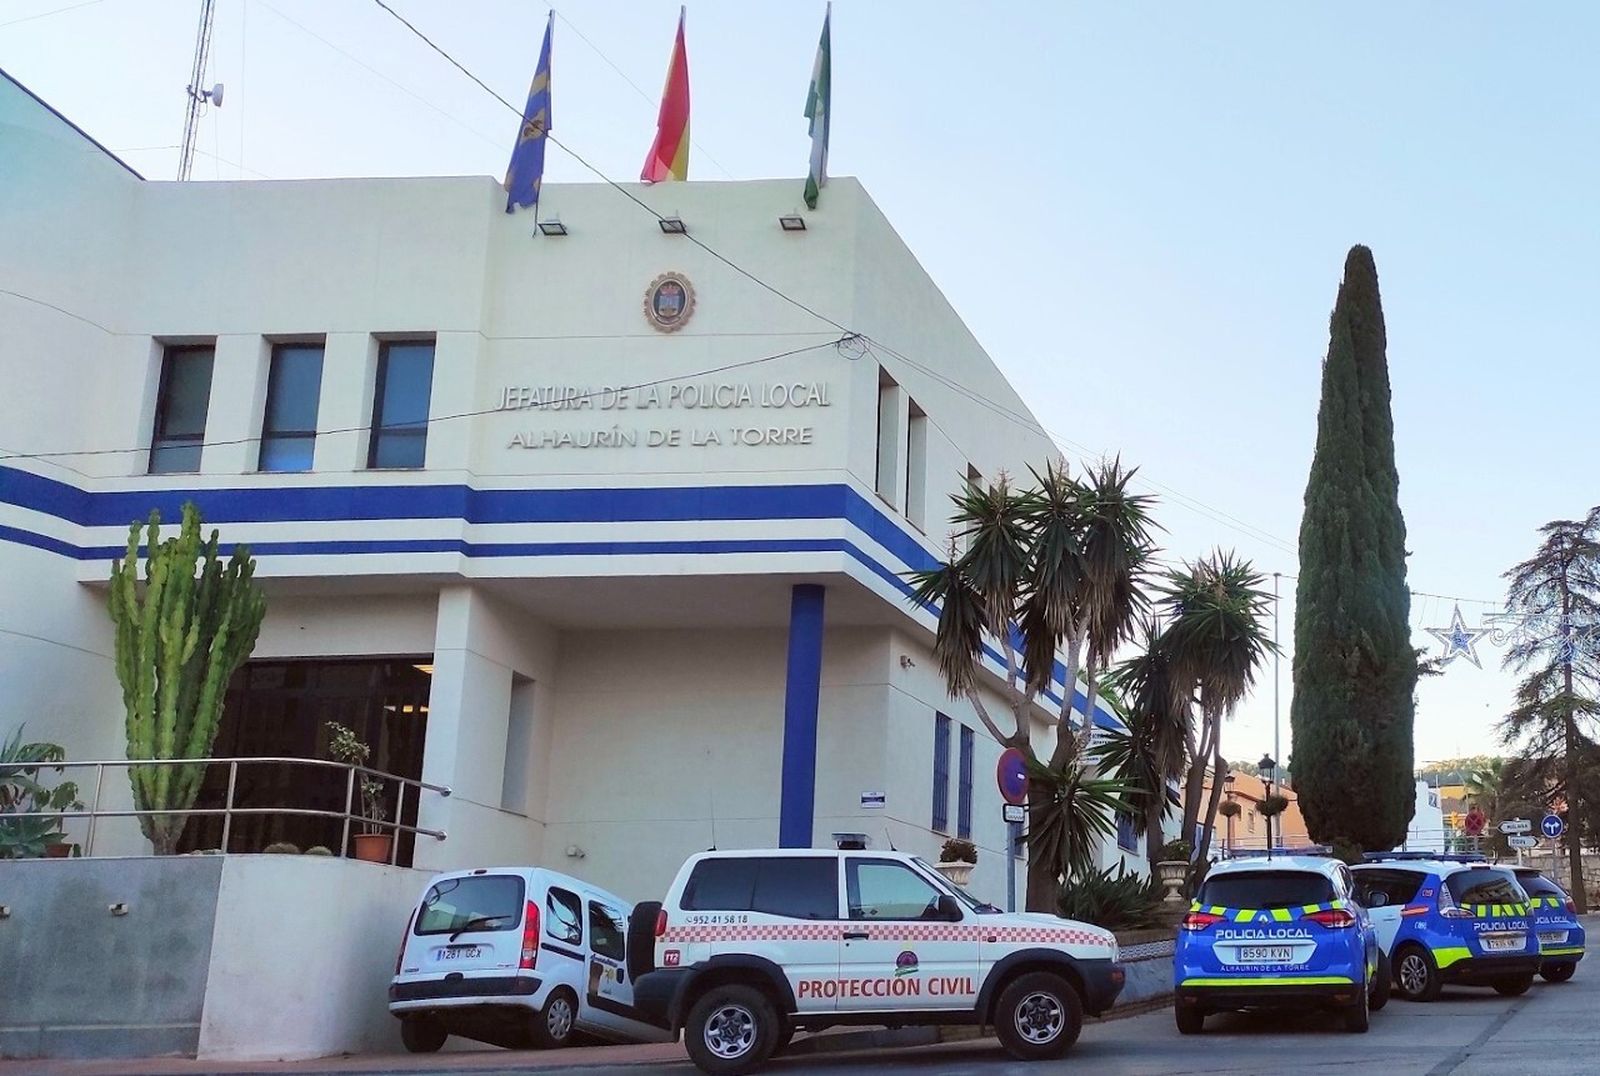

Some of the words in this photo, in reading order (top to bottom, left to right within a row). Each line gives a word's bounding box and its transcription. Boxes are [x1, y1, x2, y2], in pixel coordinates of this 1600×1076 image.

[497, 385, 594, 411] JEFATURA
[600, 386, 628, 410] DE
[635, 386, 662, 409] LA
[668, 383, 753, 409] POLICIA
[760, 382, 831, 408] LOCAL
[507, 424, 636, 449] ALHAURÍN
[648, 430, 681, 447] DE
[691, 428, 721, 446] LA
[731, 426, 813, 446] TORRE
[693, 915, 709, 924] 952
[711, 915, 721, 924] 41
[725, 915, 735, 924] 58
[738, 915, 749, 923] 18
[1474, 921, 1507, 931] POLICIA
[1508, 920, 1529, 930] LOCAL
[1215, 929, 1266, 940] POLICIA
[1269, 928, 1313, 938] LOCAL
[1243, 948, 1267, 958] 8590
[1270, 948, 1290, 958] KVN
[928, 978, 976, 996] CIVIL
